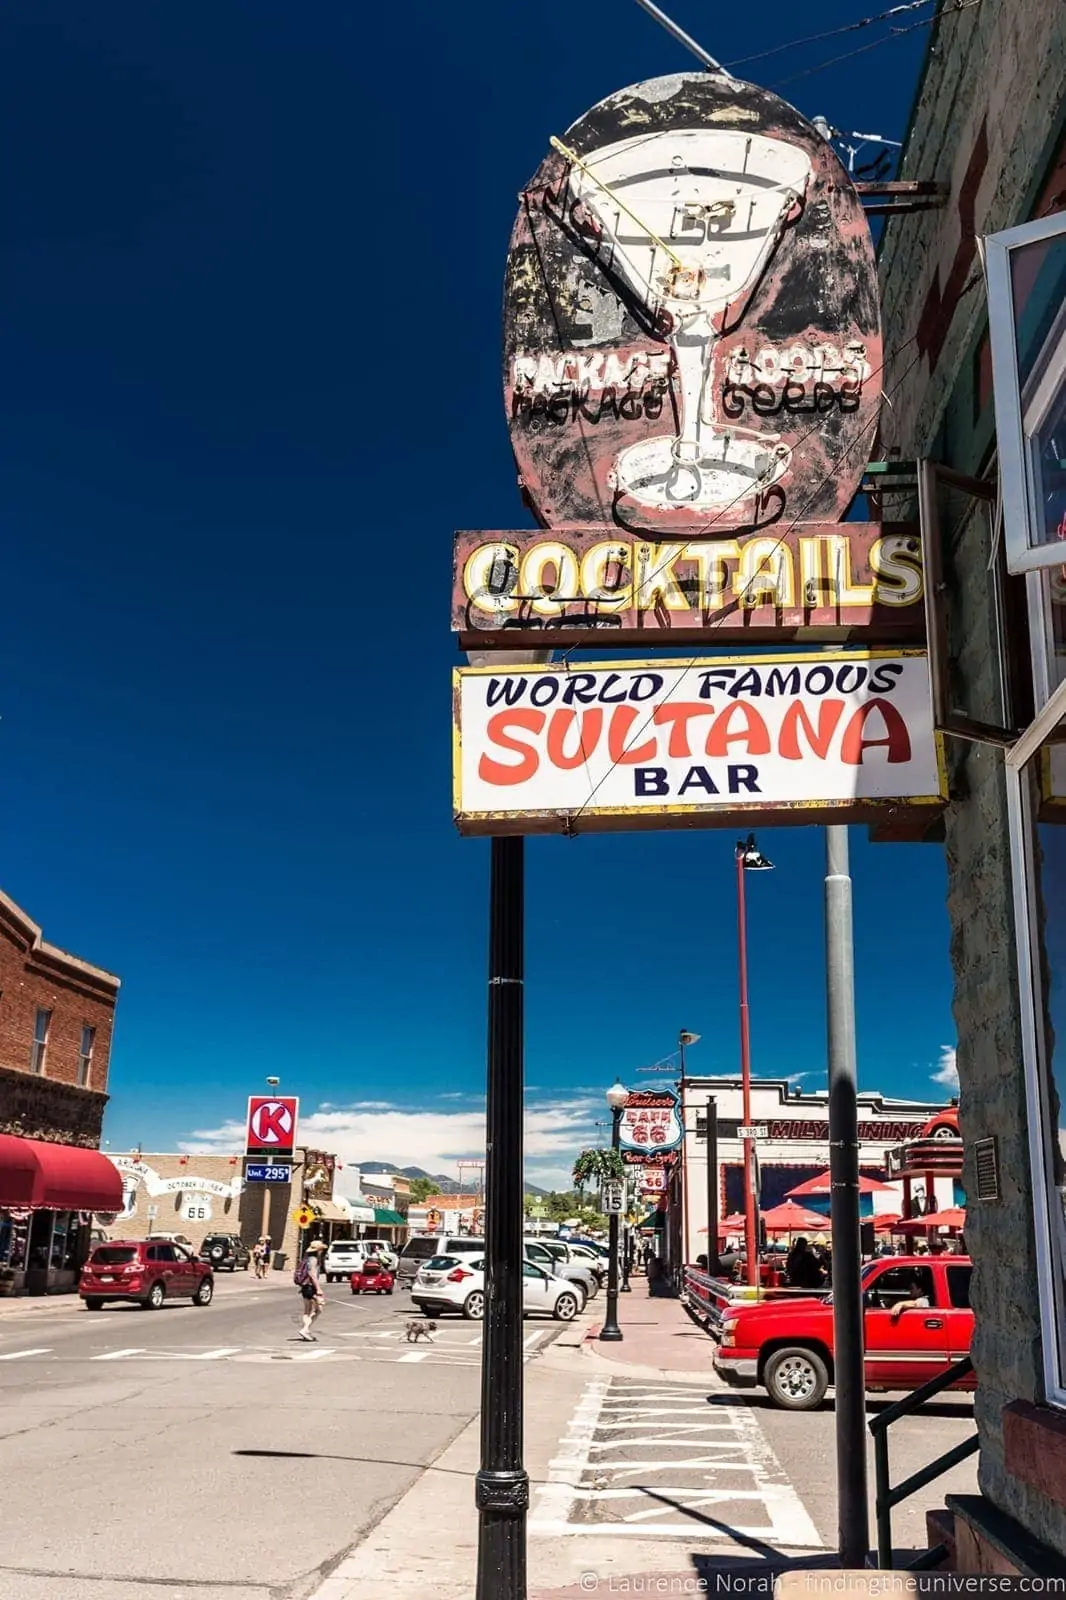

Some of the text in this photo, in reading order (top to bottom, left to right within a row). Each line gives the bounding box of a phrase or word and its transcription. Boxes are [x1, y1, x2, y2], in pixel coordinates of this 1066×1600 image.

[463, 534, 924, 614] COCKTAILS
[486, 663, 904, 708] WORLD FAMOUS
[478, 697, 912, 786] SULTANA
[633, 763, 763, 797] BAR
[259, 1106, 290, 1142] K
[626, 1110, 671, 1123] CAFE
[632, 1125, 667, 1144] 66
[751, 1121, 830, 1139] MILY
[187, 1207, 205, 1219] 66
[605, 1197, 622, 1210] 15
